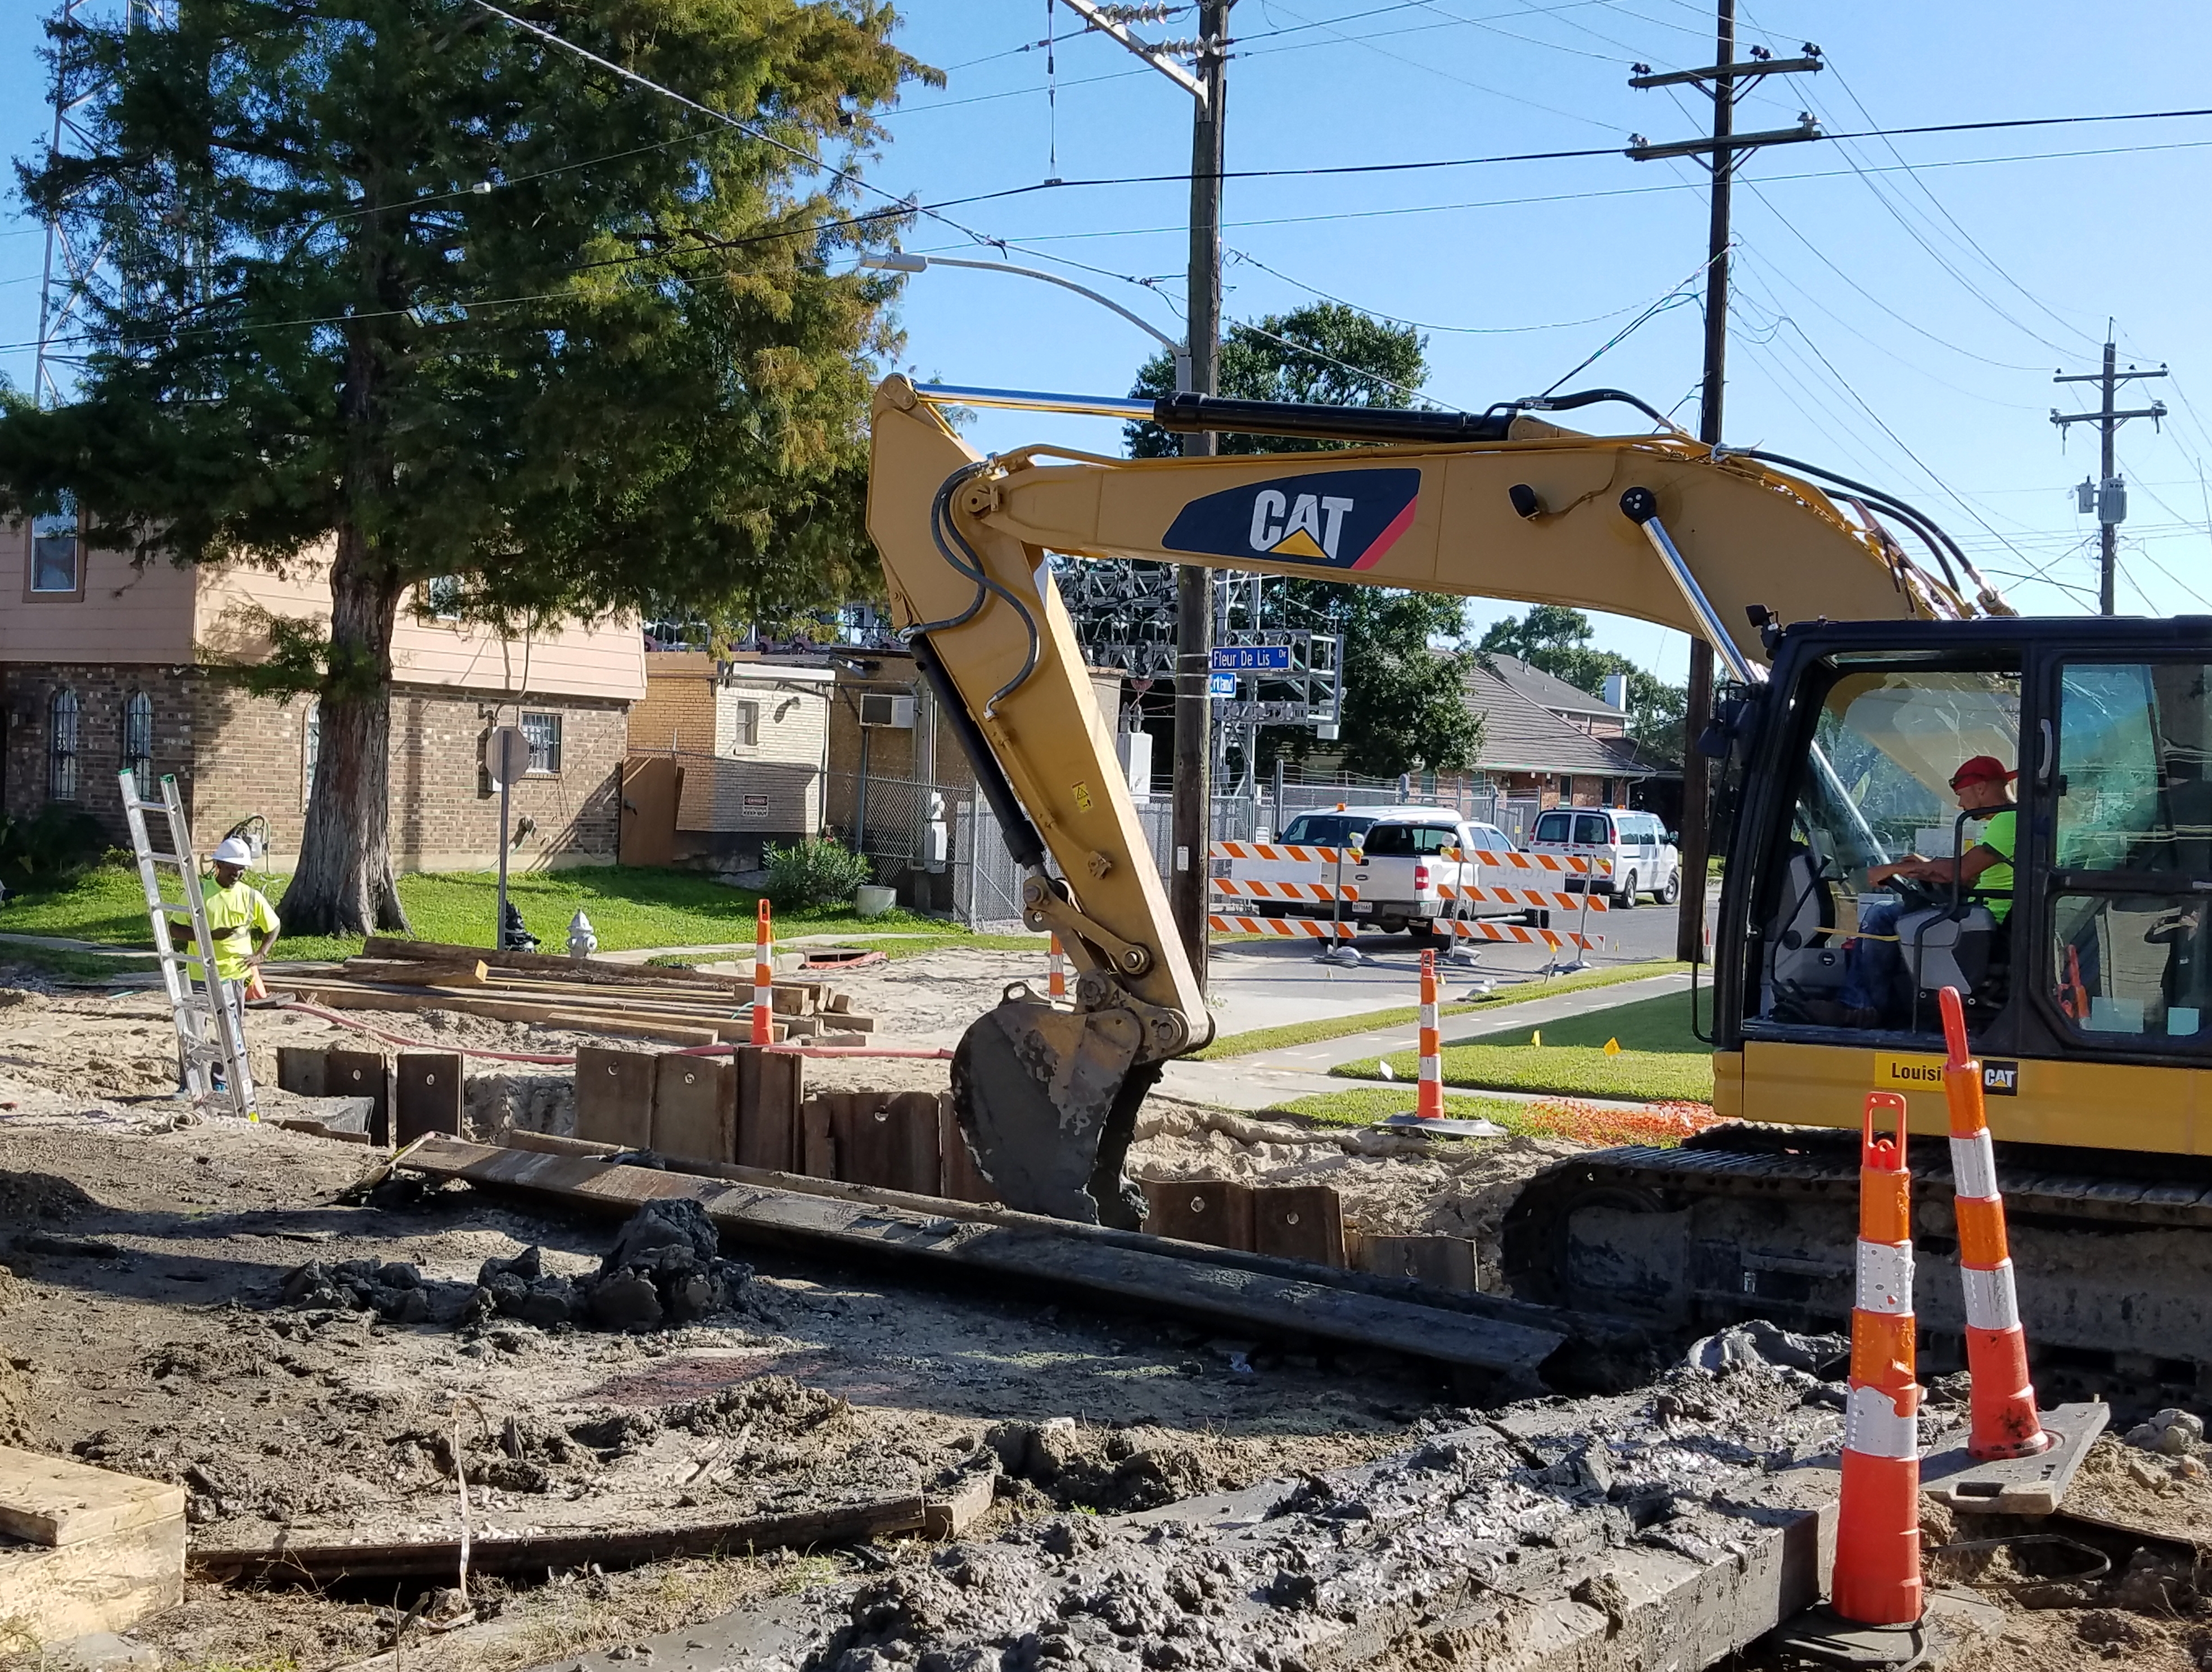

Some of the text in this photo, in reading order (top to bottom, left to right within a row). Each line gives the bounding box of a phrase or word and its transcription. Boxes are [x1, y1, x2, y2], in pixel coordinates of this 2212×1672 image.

[1249, 490, 1354, 559] CAT
[1213, 649, 1286, 667] Fleur De Lis Dr
[1984, 1069, 2014, 1088] CAT
